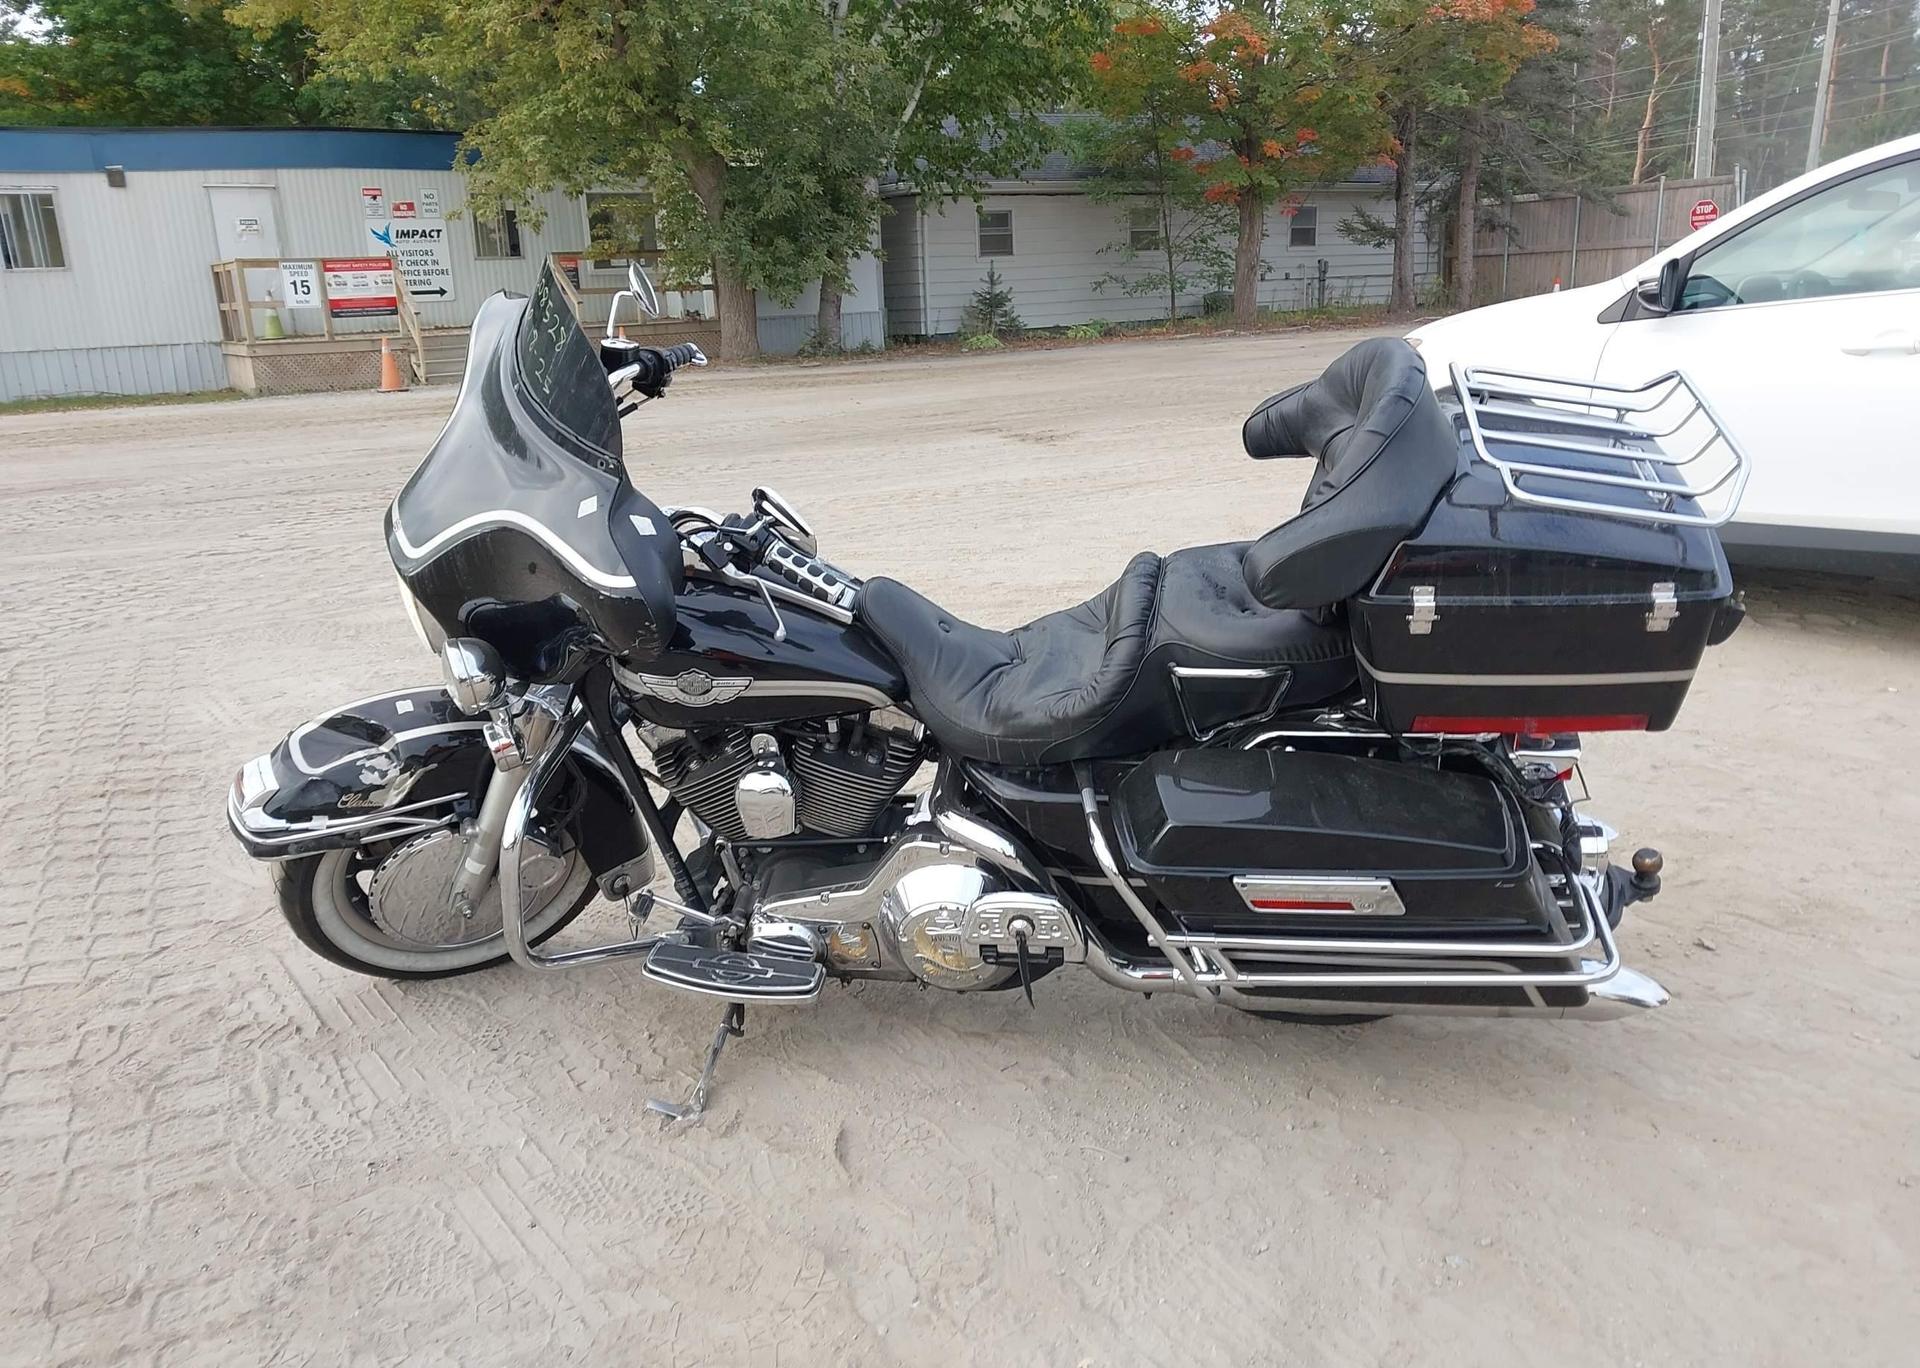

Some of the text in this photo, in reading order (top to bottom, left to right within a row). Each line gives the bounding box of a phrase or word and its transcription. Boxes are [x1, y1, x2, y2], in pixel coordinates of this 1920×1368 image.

[1696, 205, 1714, 214] STOP
[395, 229, 442, 239] IMPACT
[400, 249, 434, 257] VISITORS
[423, 268, 449, 276] BEFORE
[290, 280, 311, 296] 15
